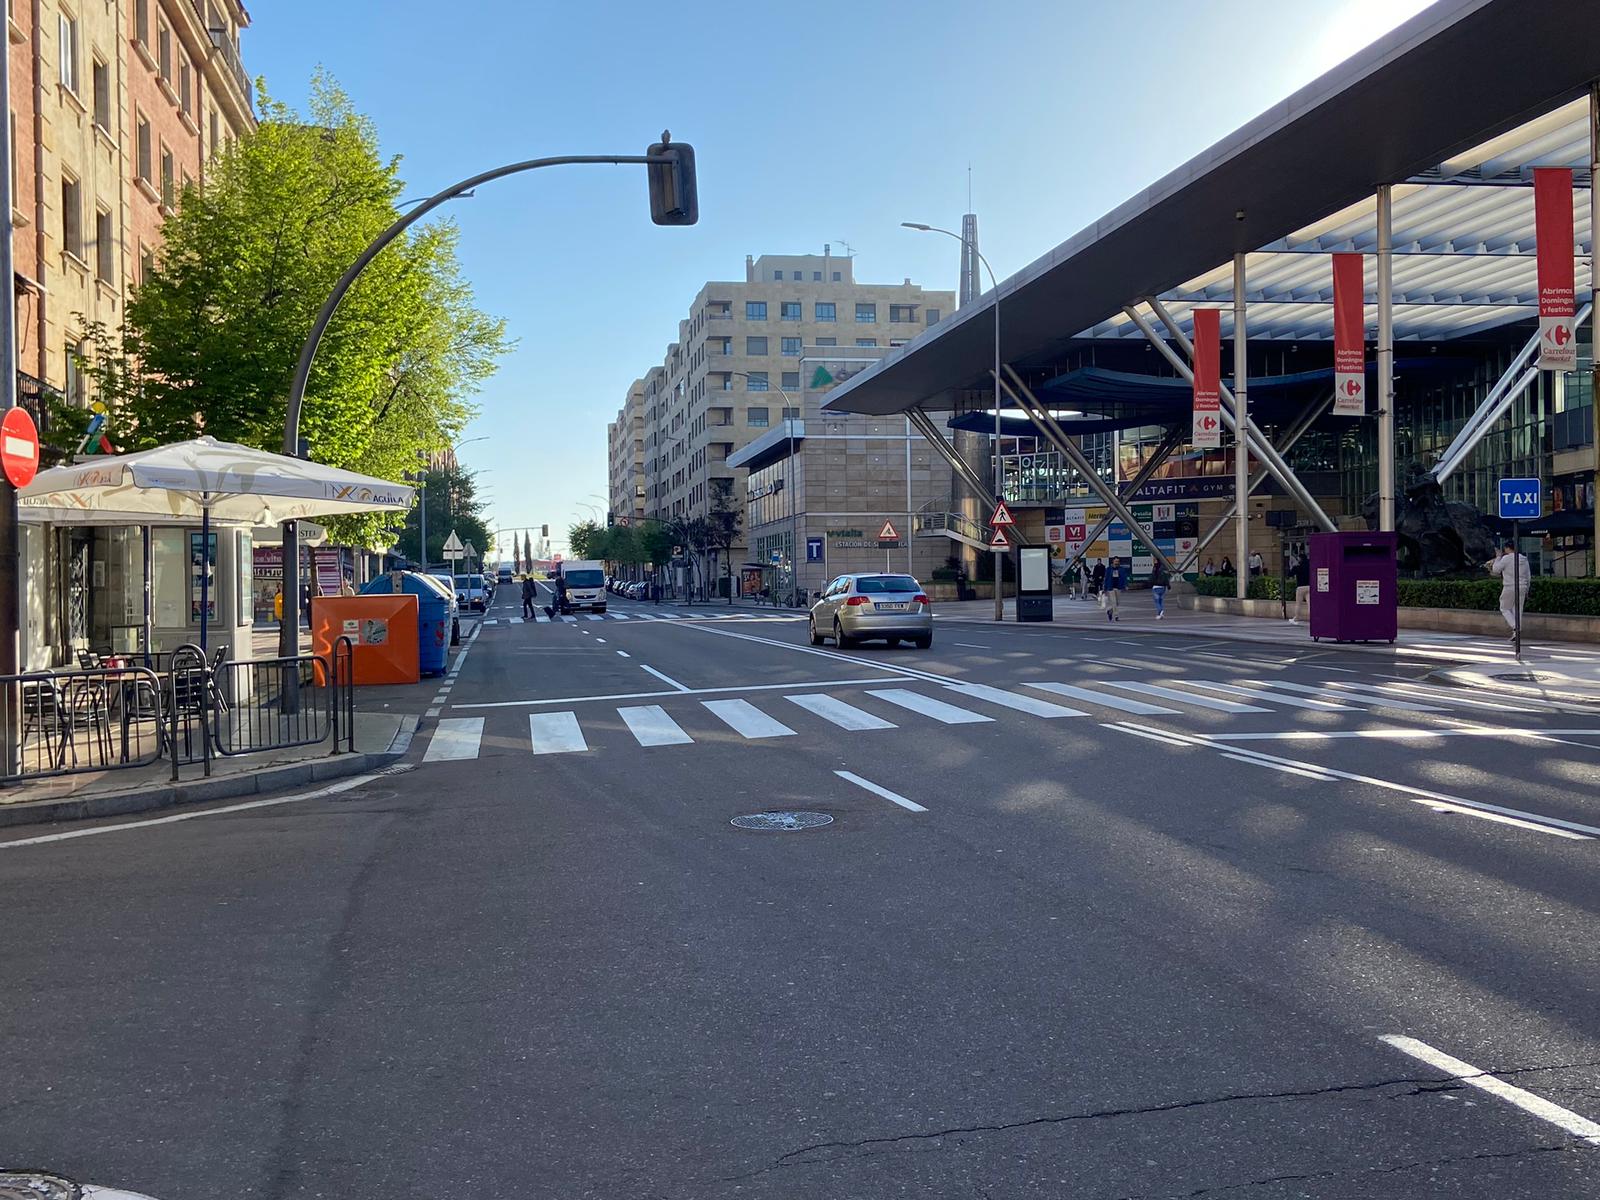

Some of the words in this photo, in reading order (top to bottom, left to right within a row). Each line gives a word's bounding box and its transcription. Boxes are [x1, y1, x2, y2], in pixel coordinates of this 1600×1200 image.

[1542, 287, 1573, 295] Abrimos
[1541, 297, 1574, 305] Domingos
[1543, 347, 1576, 355] Carrefour
[1135, 484, 1187, 496] ALTAFIT
[1202, 484, 1224, 492] GYM
[1502, 492, 1538, 504] TAXI
[808, 542, 821, 558] T
